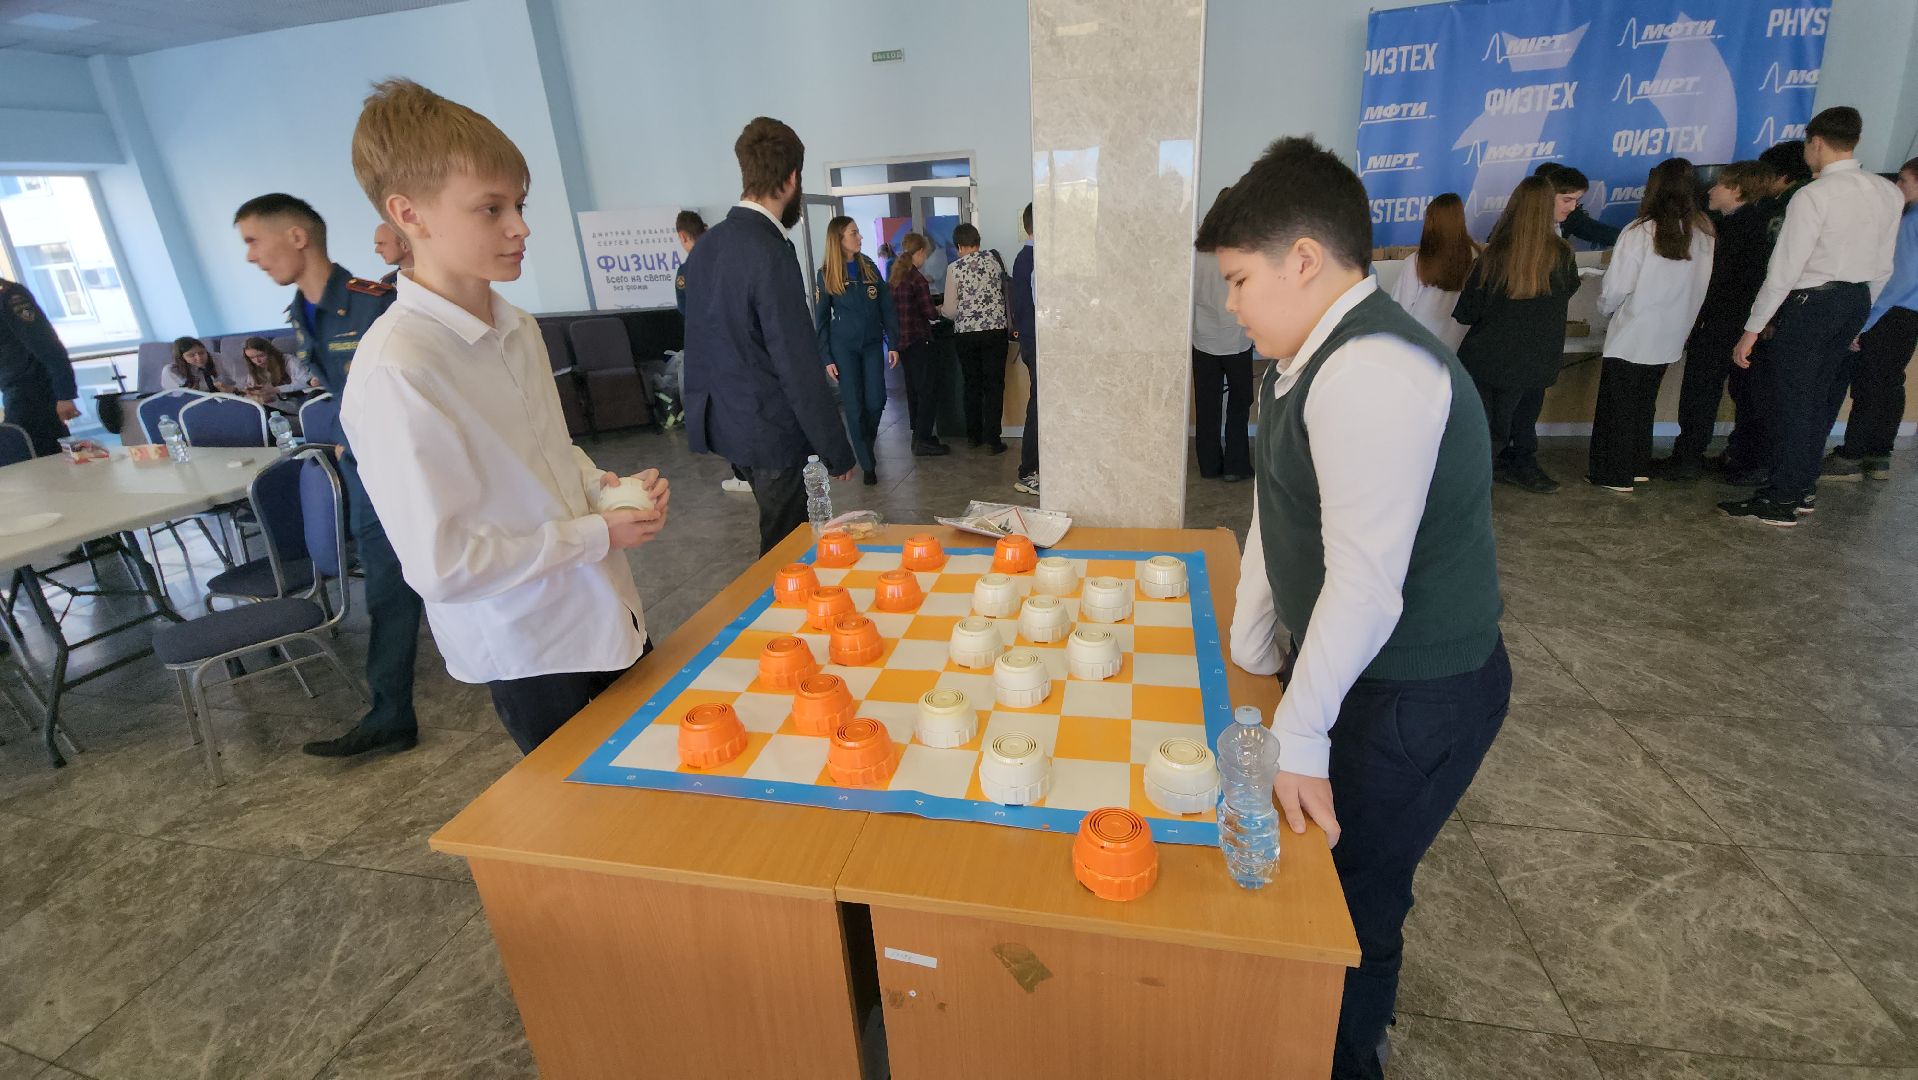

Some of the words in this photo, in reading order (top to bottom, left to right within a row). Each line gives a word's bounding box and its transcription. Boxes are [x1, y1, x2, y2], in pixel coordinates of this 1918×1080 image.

[1641, 20, 1716, 40] МФТИ
[1507, 34, 1568, 54] MIPT
[1637, 77, 1700, 95] MIPT
[1485, 81, 1578, 116] ФИЗТЕХ
[1364, 102, 1428, 120] МФТИ
[1486, 141, 1556, 160] МФТИ
[1612, 125, 1708, 157] ФИЗТЕХ
[1367, 153, 1419, 169] MIPT
[597, 250, 681, 273] ФИЗИКА
